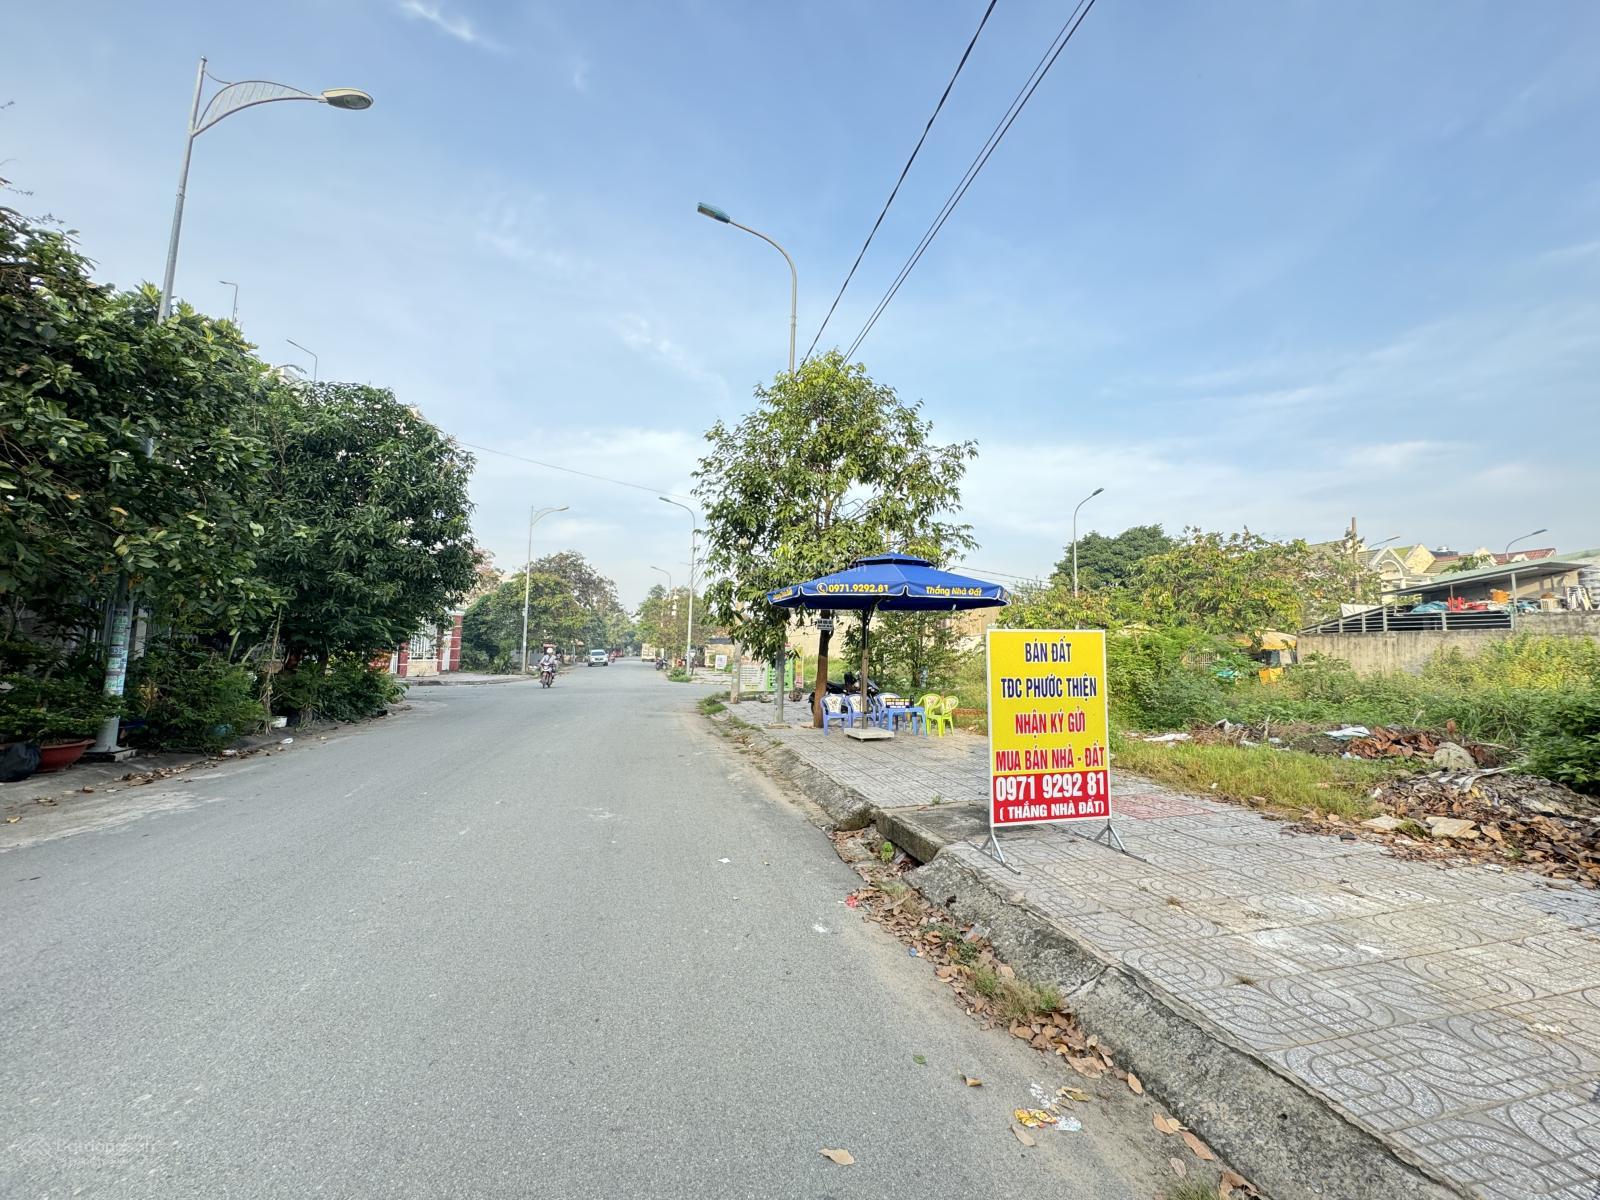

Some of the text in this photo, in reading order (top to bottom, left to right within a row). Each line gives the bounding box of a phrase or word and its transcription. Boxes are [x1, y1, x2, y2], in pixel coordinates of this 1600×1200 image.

[828, 584, 888, 593] 0971.9292.81
[926, 585, 950, 597] Thắng
[1025, 636, 1072, 663] BÁN ĐẤT
[1001, 673, 1097, 701] TĐC PHƯỚC THIỆN
[1015, 706, 1086, 739] NHẬN KÝ GỬI
[996, 750, 1021, 771] MUA
[1025, 745, 1048, 770] BÁN
[1051, 744, 1074, 768] NHÀ
[1085, 740, 1105, 767] ĐẤT
[995, 771, 1105, 801] 0971 9292 81
[1008, 800, 1047, 819] THẮNG
[1051, 800, 1075, 816] NHÀ
[1078, 796, 1105, 815] ĐẤT)
